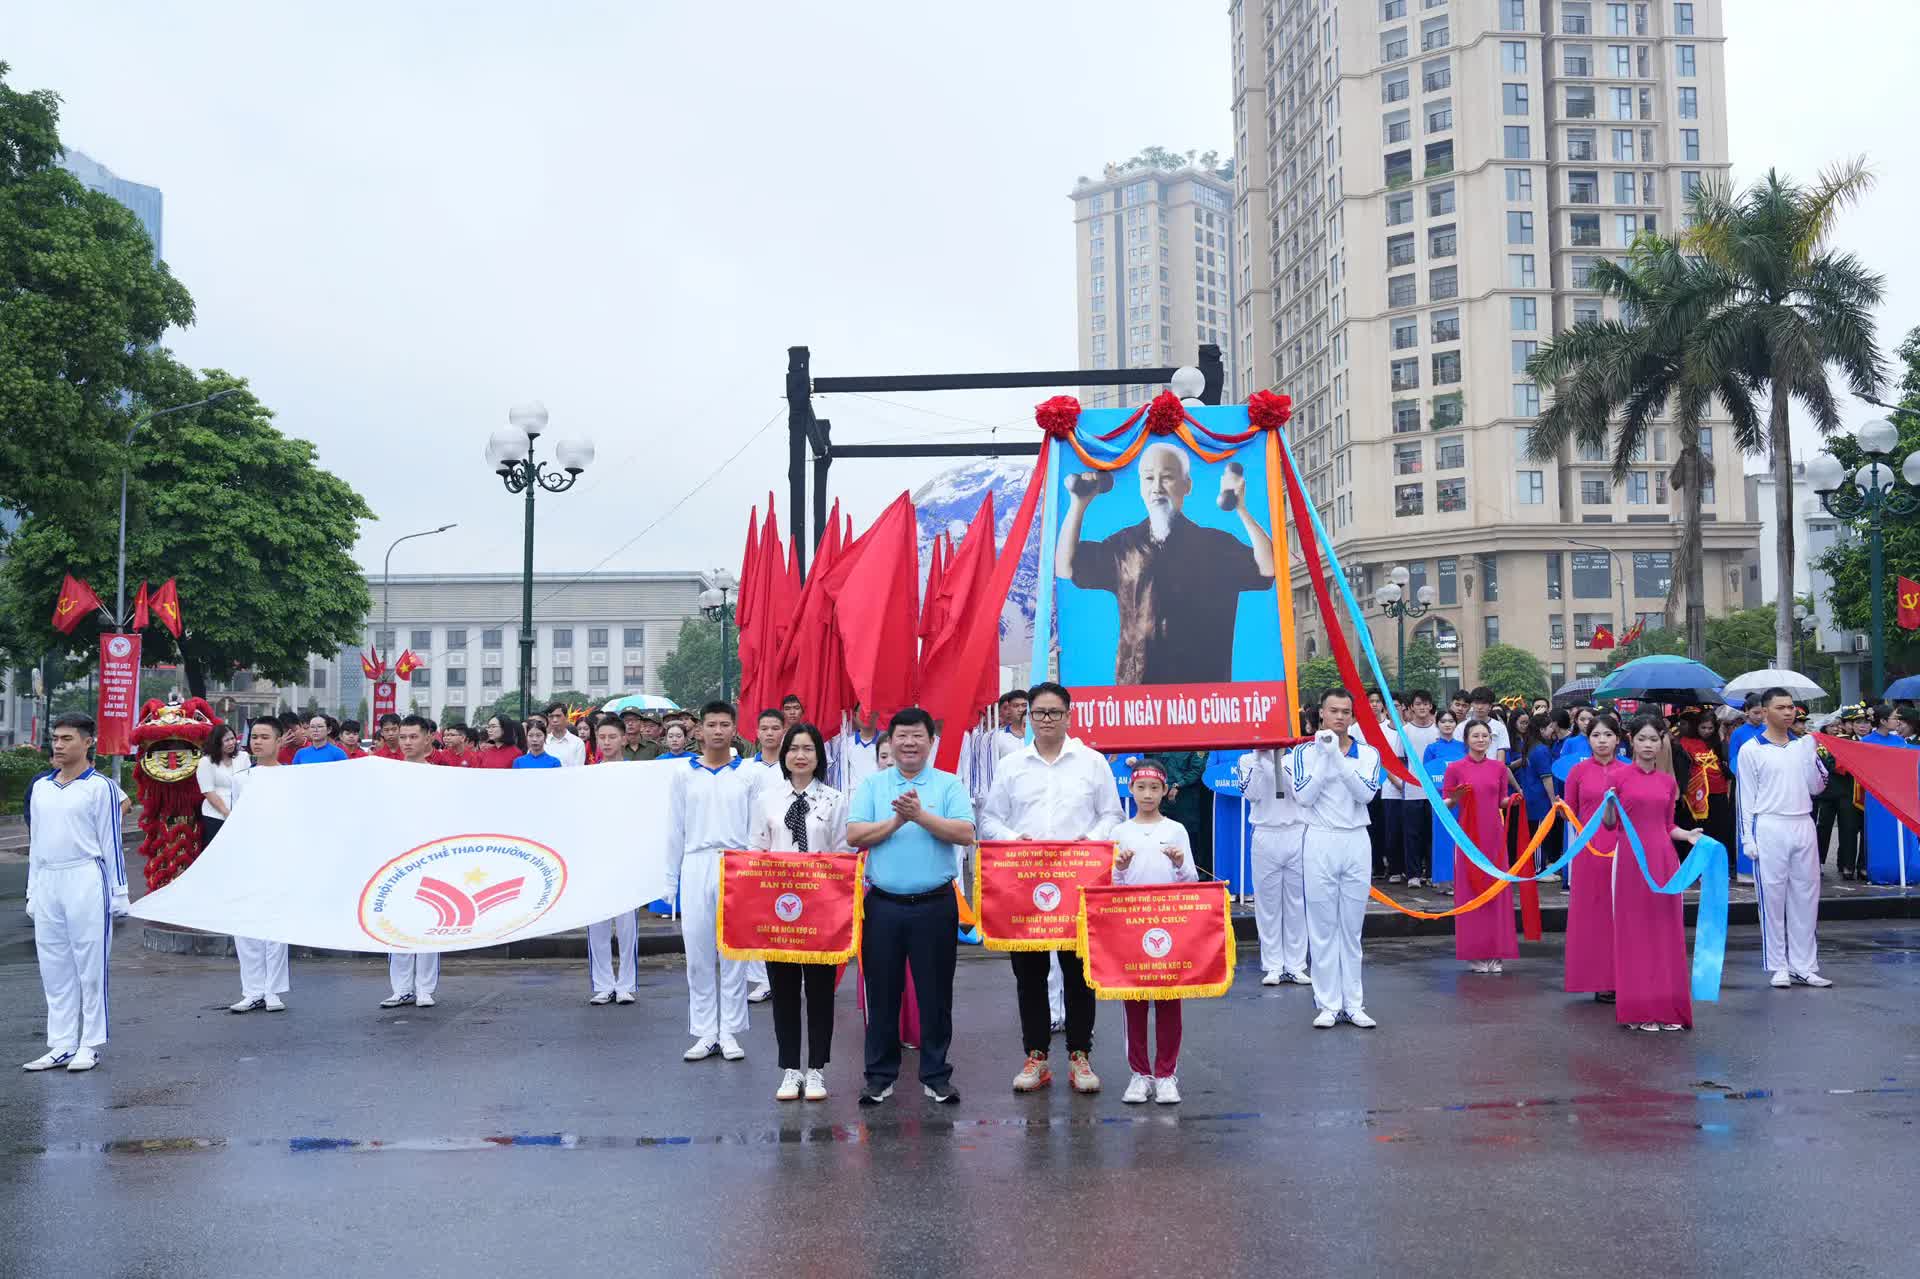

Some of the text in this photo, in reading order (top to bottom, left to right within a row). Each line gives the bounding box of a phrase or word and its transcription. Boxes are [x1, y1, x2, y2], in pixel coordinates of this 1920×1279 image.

[1575, 639, 1591, 647] Salo
[1098, 695, 1120, 727] TÔI
[1124, 693, 1162, 726] NGÀY
[1166, 692, 1197, 725] NÀO
[1201, 692, 1240, 724] CŨNG
[377, 883, 393, 899] HỘI
[387, 866, 407, 885] THỂ
[404, 857, 428, 872] DỤC
[427, 845, 450, 861] THỂ
[451, 845, 484, 855] THAO
[486, 845, 532, 860] PHƯỜNG
[1017, 871, 1037, 879] BAN
[760, 881, 779, 889] BAN
[1126, 917, 1145, 925] BAN
[424, 927, 472, 936] 2025
